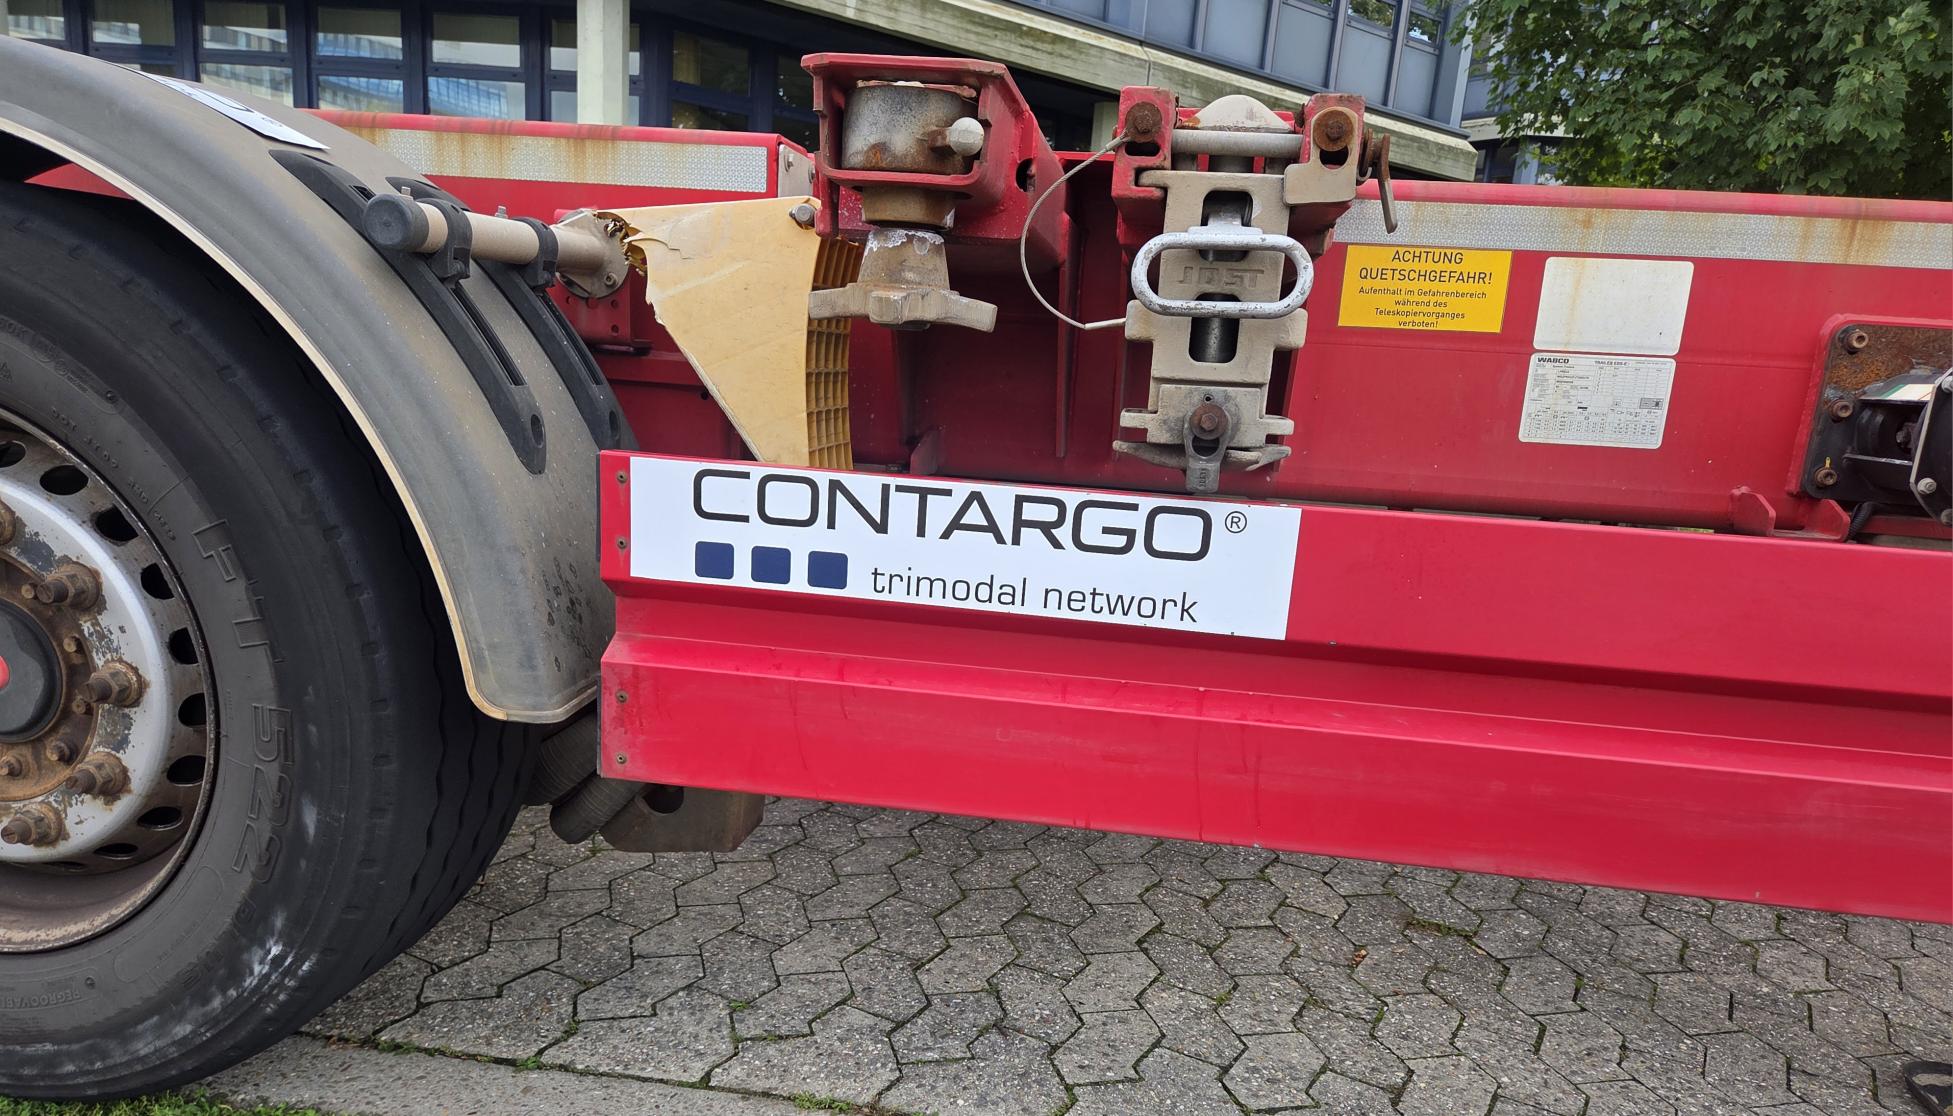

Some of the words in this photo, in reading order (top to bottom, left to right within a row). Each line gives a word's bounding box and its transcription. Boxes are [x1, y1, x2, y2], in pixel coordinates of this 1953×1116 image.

[1391, 250, 1464, 265] ACHTUNG
[1177, 265, 1265, 289] JOST
[1359, 267, 1493, 285] QUETSCHGEFAHR!
[1358, 286, 1403, 296] Aufenthalt
[1404, 288, 1415, 296] im
[1417, 289, 1487, 299] Gefahrenbereich
[1394, 298, 1431, 307] während
[1432, 299, 1448, 308] des
[1374, 307, 1466, 321] Teleskopiervorganges
[1398, 319, 1439, 328] verboten!
[692, 467, 1213, 562] CONTARGO
[871, 566, 1027, 608] trimodal
[1043, 586, 1198, 624] network
[231, 702, 296, 884] 522
